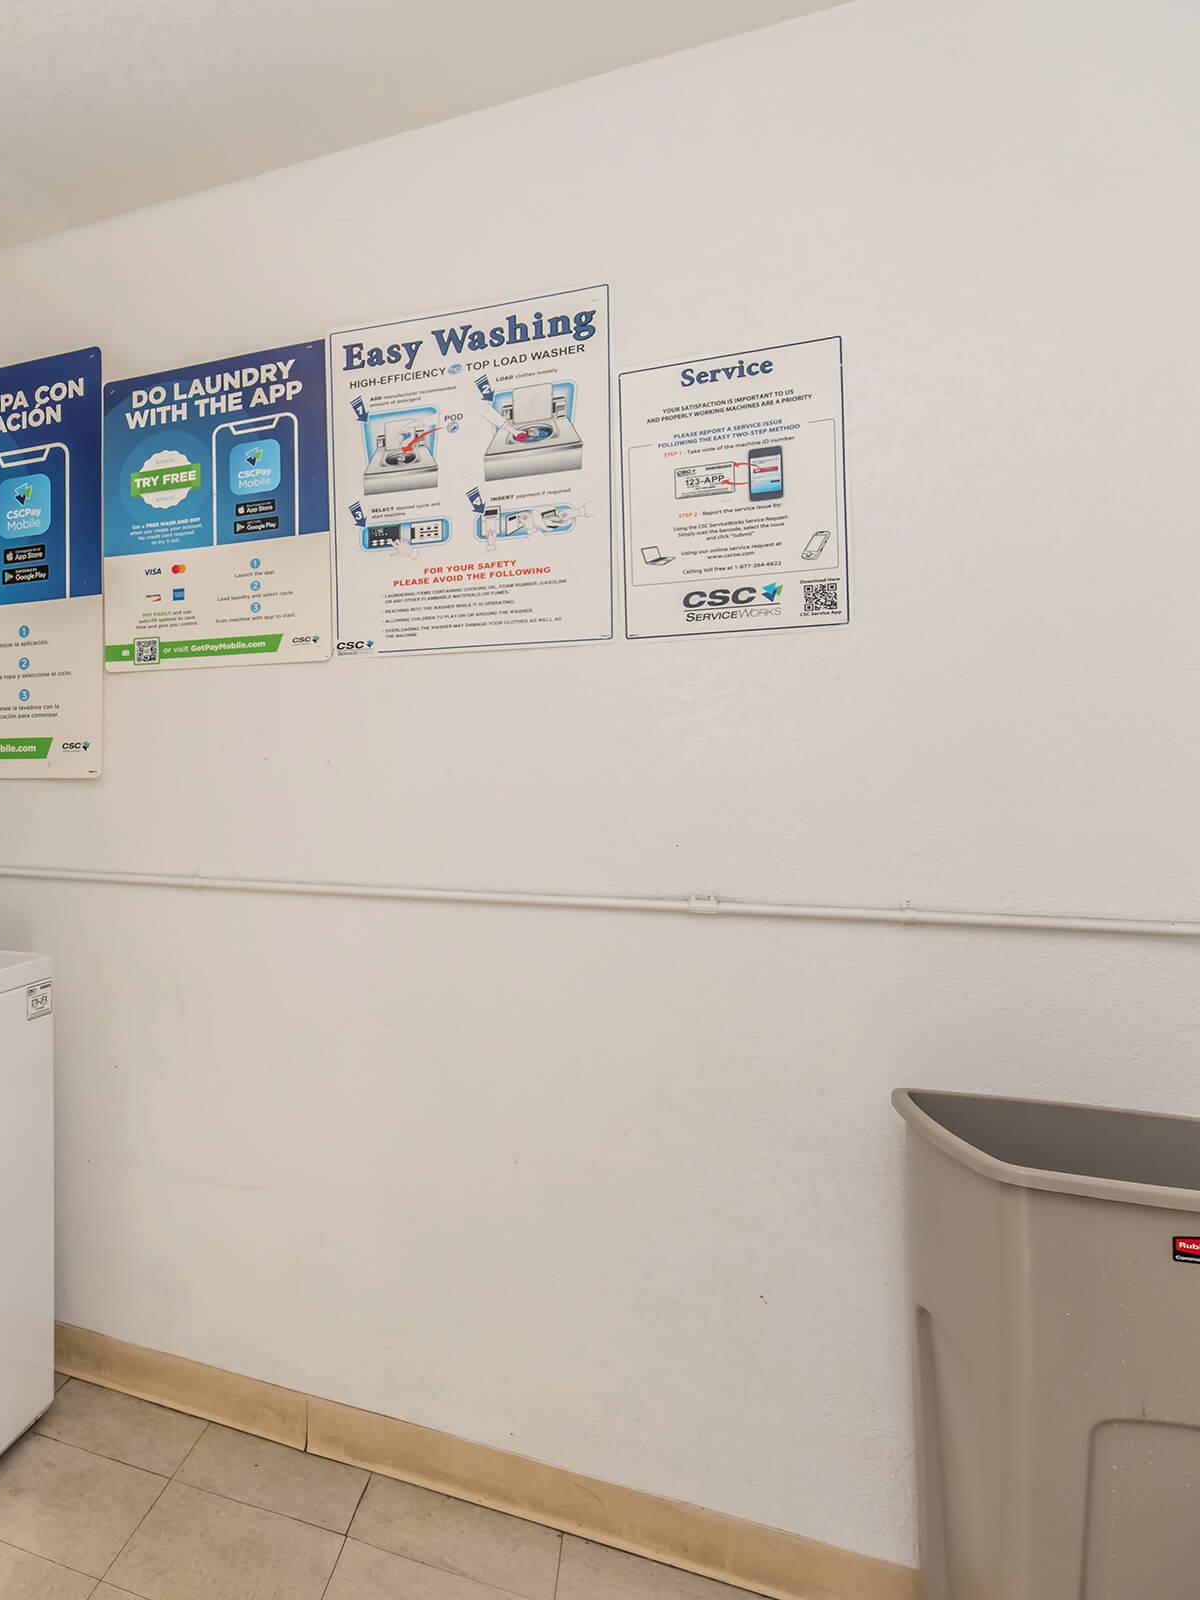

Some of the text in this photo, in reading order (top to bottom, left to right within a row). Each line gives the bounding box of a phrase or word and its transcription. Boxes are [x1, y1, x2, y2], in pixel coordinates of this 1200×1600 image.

[342, 309, 596, 371] Easy Washing
[466, 360, 490, 372] TOP
[494, 354, 528, 368] LOAD
[530, 344, 585, 360] WASHER
[350, 368, 446, 389] HIGH-EFFICIENCY
[680, 359, 774, 388] Service
[34, 377, 85, 402] CON
[132, 358, 296, 409] DO LAUNDRY
[482, 384, 490, 394] 2
[125, 380, 303, 430] WITH THE APP
[662, 412, 692, 422] PROPERLY
[694, 408, 724, 416] WORKING
[726, 402, 760, 412] MACHINES
[782, 394, 812, 404] PRIORITY
[681, 400, 726, 412] SATISFACTION
[735, 392, 773, 402] IMPORTANT
[444, 413, 464, 422] POD
[699, 427, 725, 435] REPORT
[733, 422, 761, 430] SERVICE
[658, 439, 698, 448] FOLLOWING
[769, 424, 800, 432] METHOD
[134, 470, 197, 489] TRY FREE
[6, 508, 42, 519] CSCPay
[354, 511, 362, 520] 3
[7, 518, 41, 531] Mobile
[144, 568, 162, 576] VISA
[424, 560, 516, 575] FOR YOUR SAFETY
[15, 573, 35, 581] Google
[393, 578, 430, 586] PLEASE
[433, 574, 463, 583] AVOID
[490, 566, 551, 578] FOLLOWING
[682, 586, 756, 609] CSC
[173, 645, 188, 653] visit
[190, 640, 266, 652] GetPayMobile.com
[292, 636, 311, 644] CSC
[336, 640, 364, 650] CSC
[21, 659, 27, 668] 2
[22, 690, 27, 700] 3
[62, 742, 81, 750] CSC
[1178, 1242, 1200, 1250] Rub
